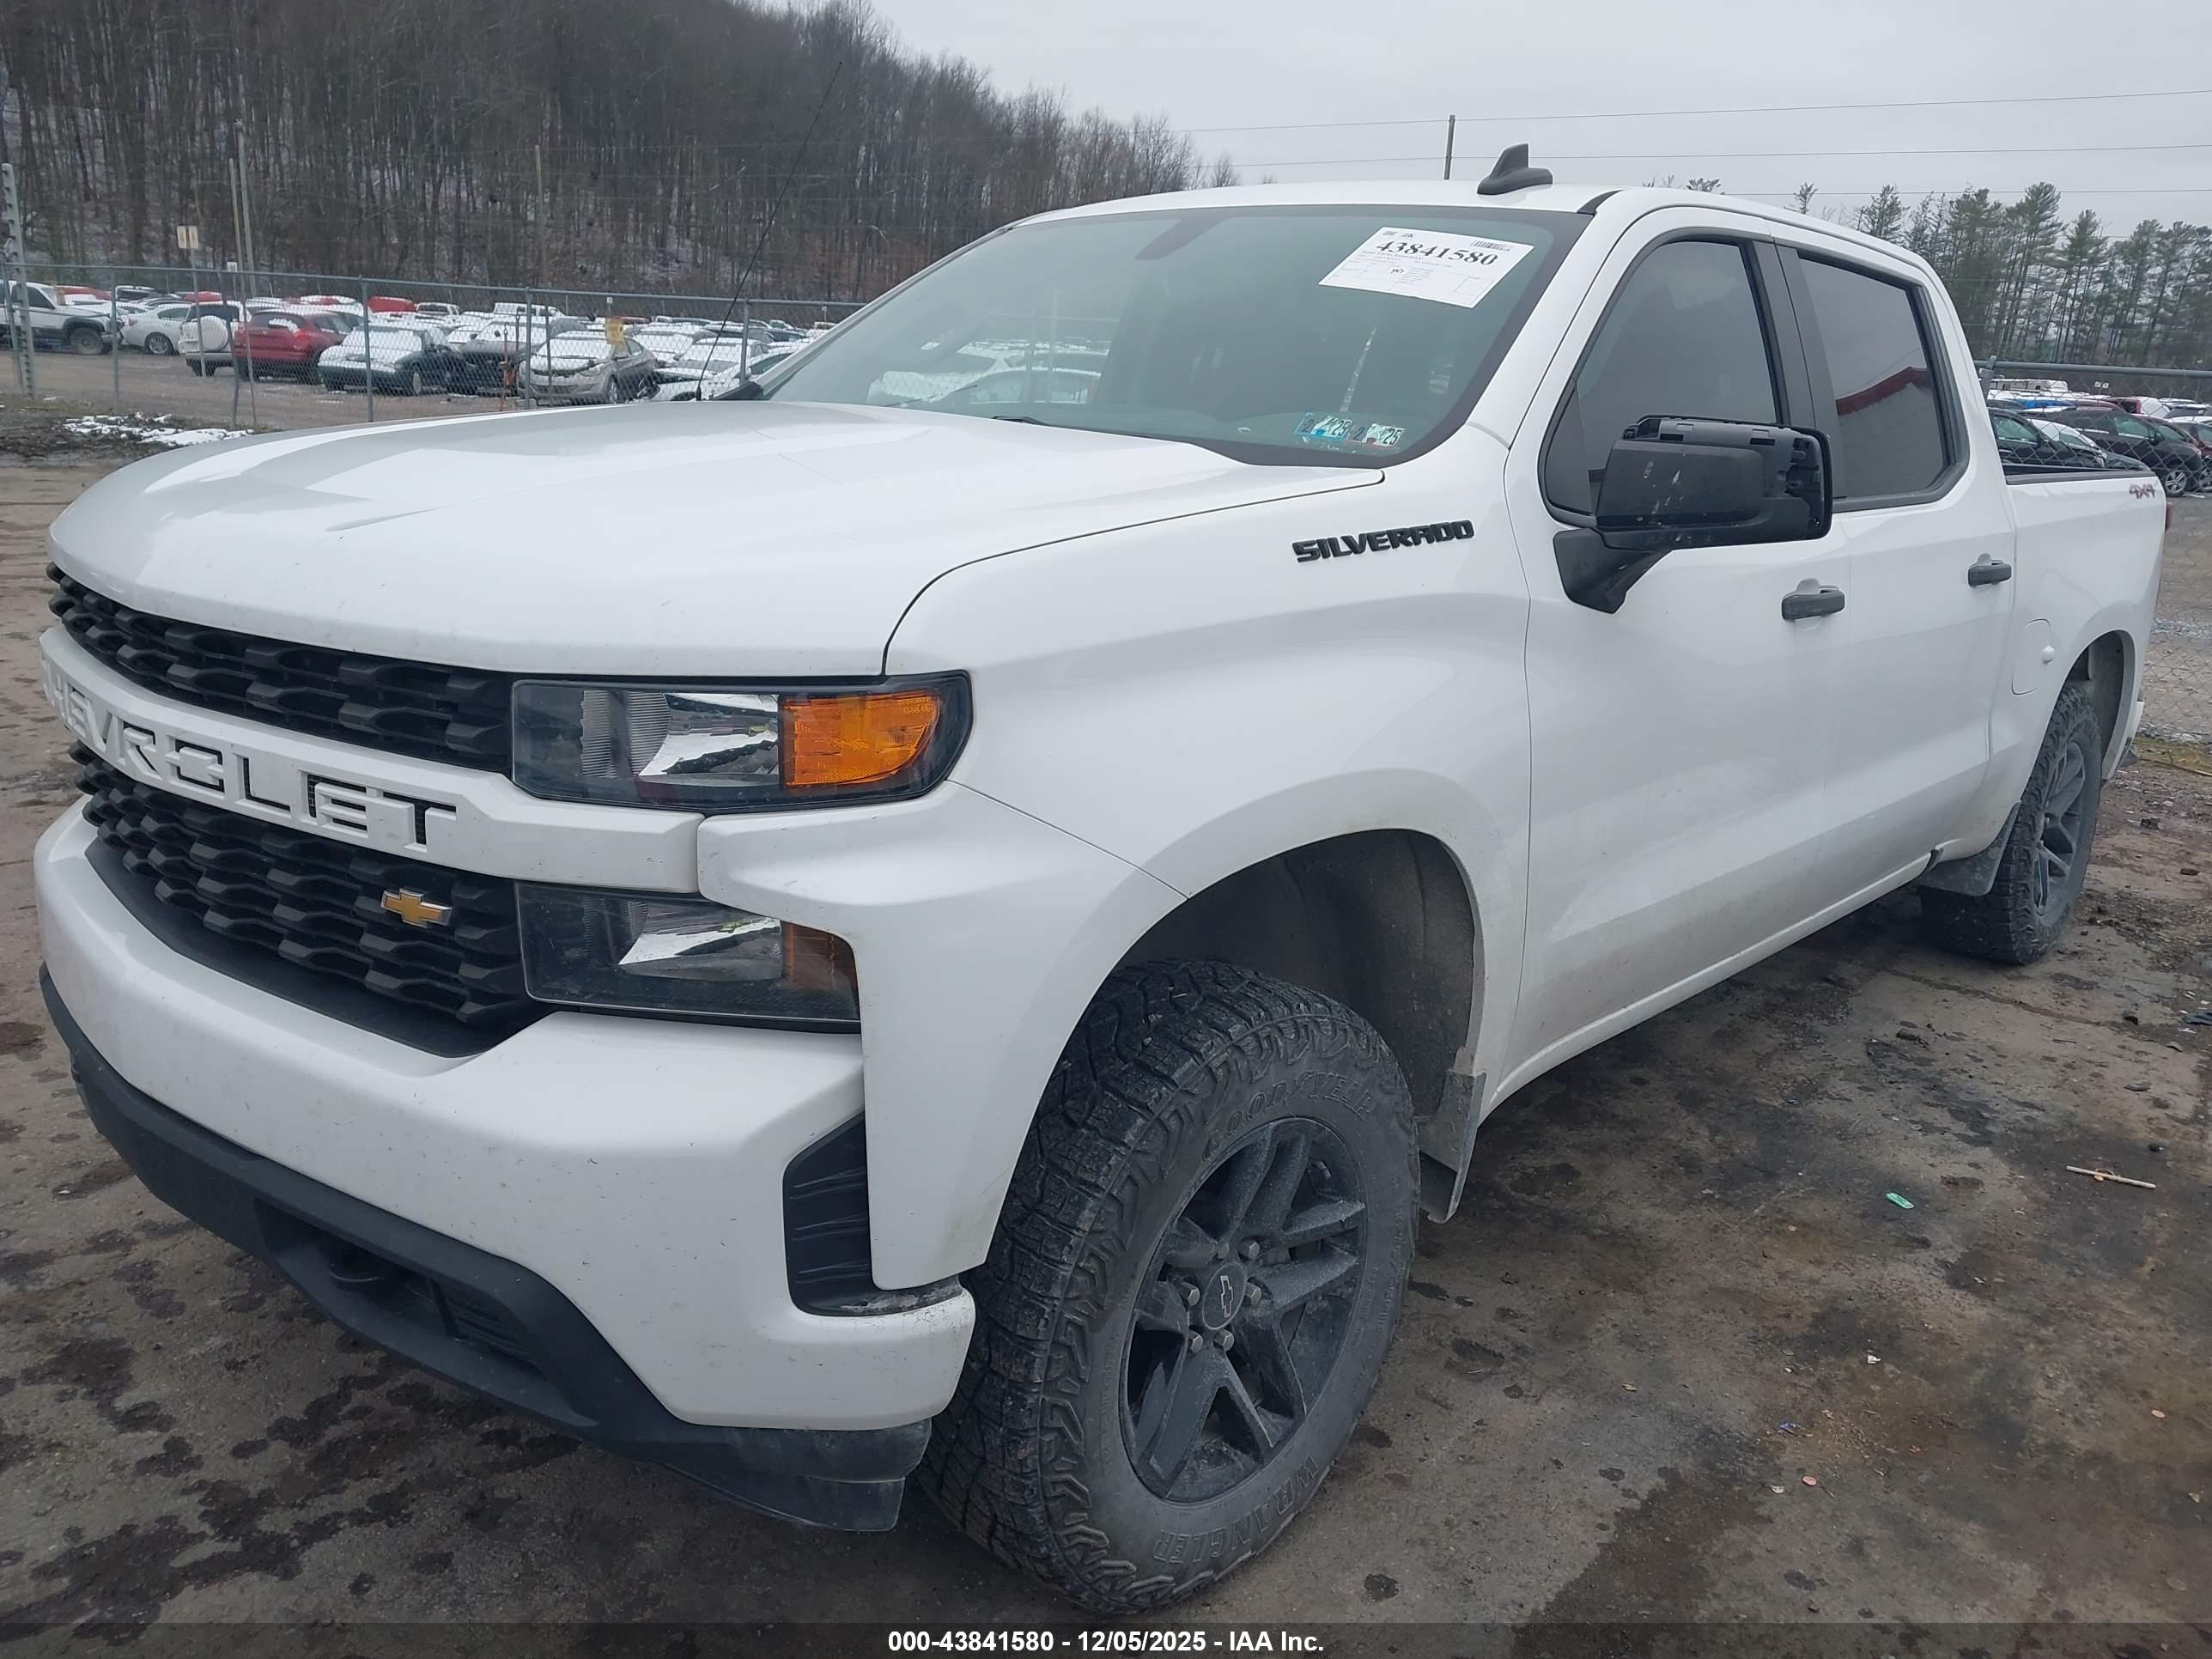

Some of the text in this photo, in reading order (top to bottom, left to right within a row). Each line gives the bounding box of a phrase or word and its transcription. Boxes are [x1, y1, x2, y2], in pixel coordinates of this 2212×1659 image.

[1376, 240, 1498, 266] 43841580
[1382, 428, 1402, 445] 25
[1291, 520, 1475, 563] SILVERADO
[1152, 1454, 1320, 1565] WRANGLER
